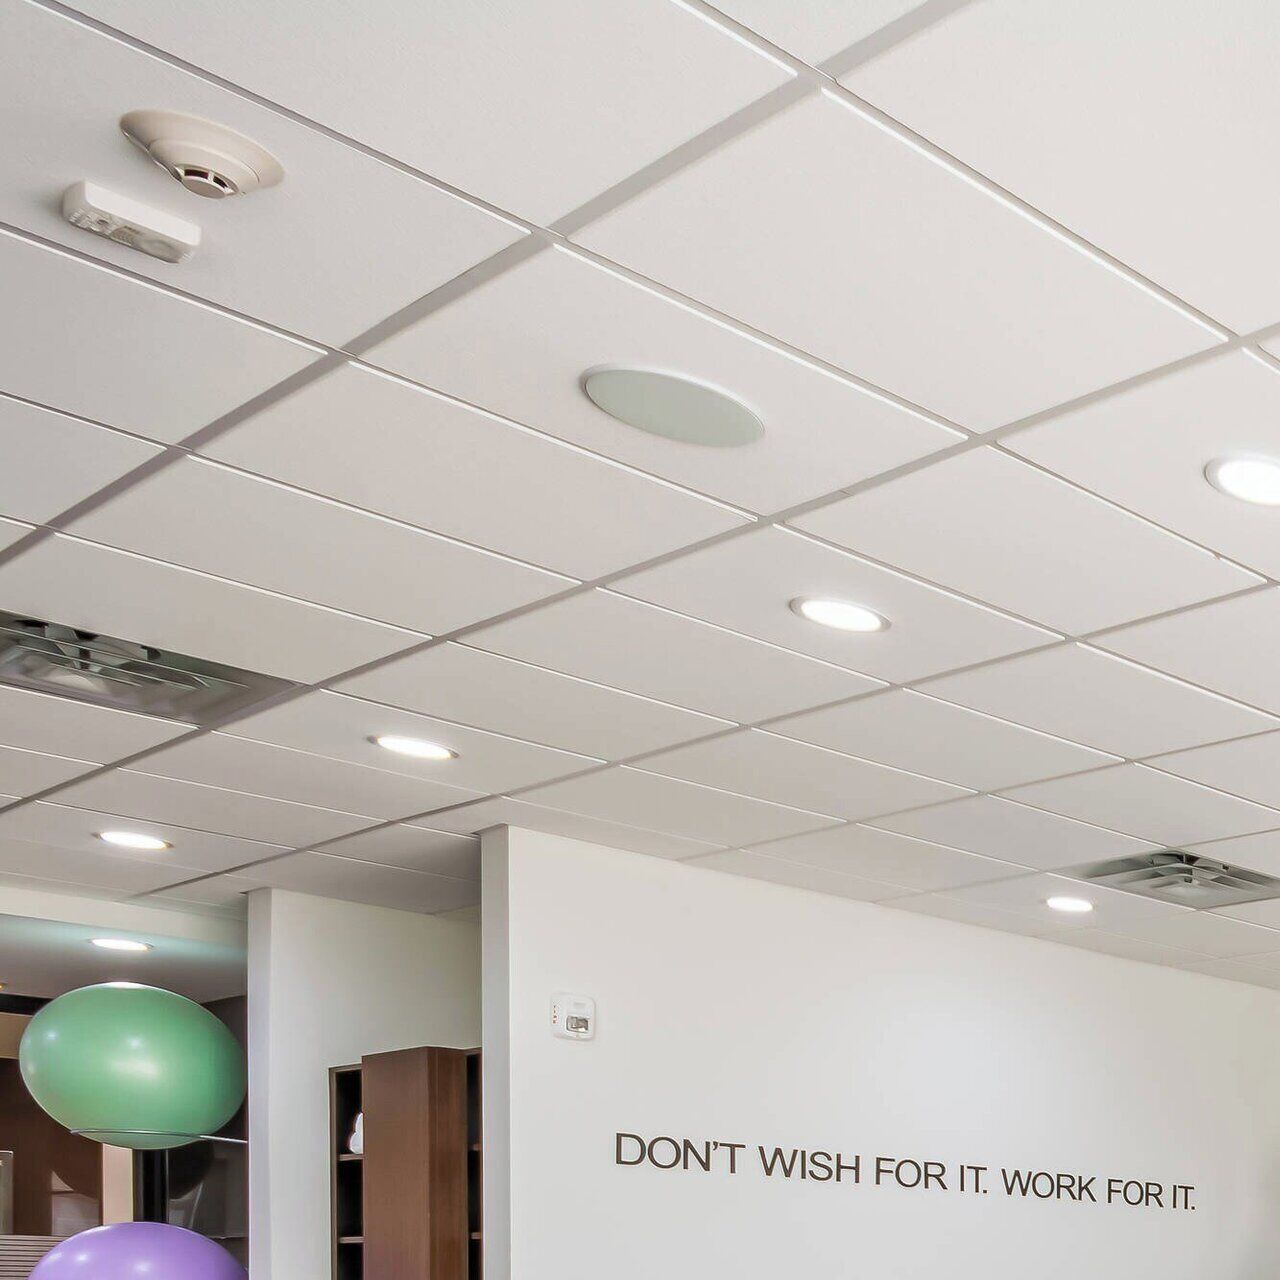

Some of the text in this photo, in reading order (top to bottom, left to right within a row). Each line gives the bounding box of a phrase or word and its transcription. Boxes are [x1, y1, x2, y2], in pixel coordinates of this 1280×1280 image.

[615, 1132, 1197, 1211] DON'T WISH FOR IT. WORK FOR IT.
